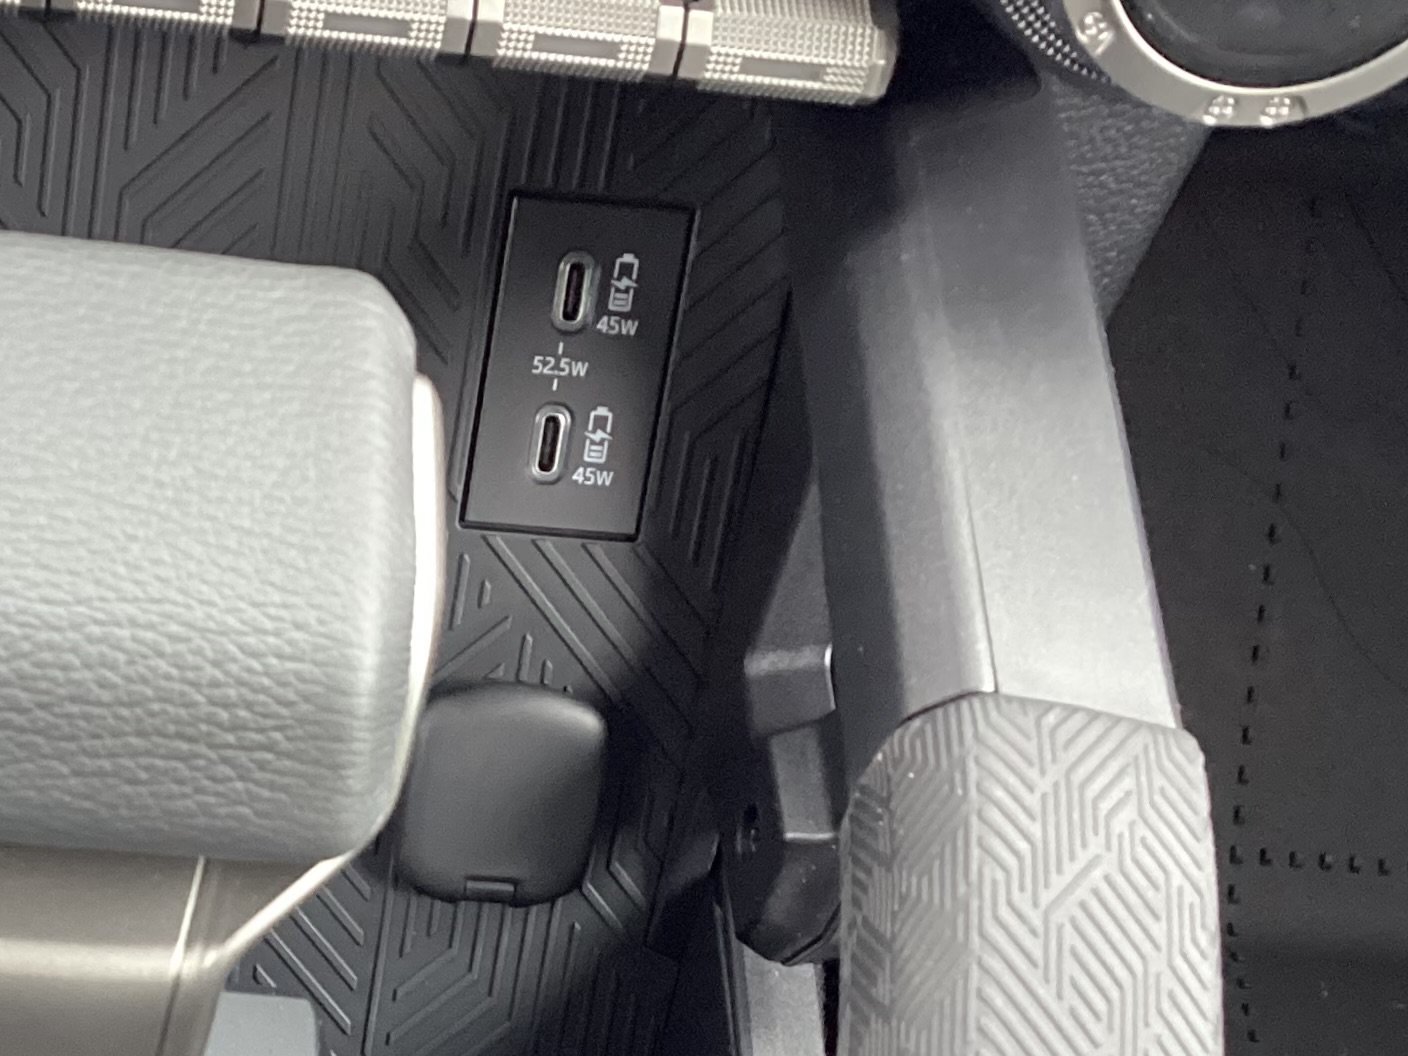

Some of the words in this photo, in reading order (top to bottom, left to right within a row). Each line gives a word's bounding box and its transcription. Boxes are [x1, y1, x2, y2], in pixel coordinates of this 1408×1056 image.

[596, 316, 638, 336] 45W
[531, 355, 589, 377] 52.5W
[571, 467, 614, 486] 45W
